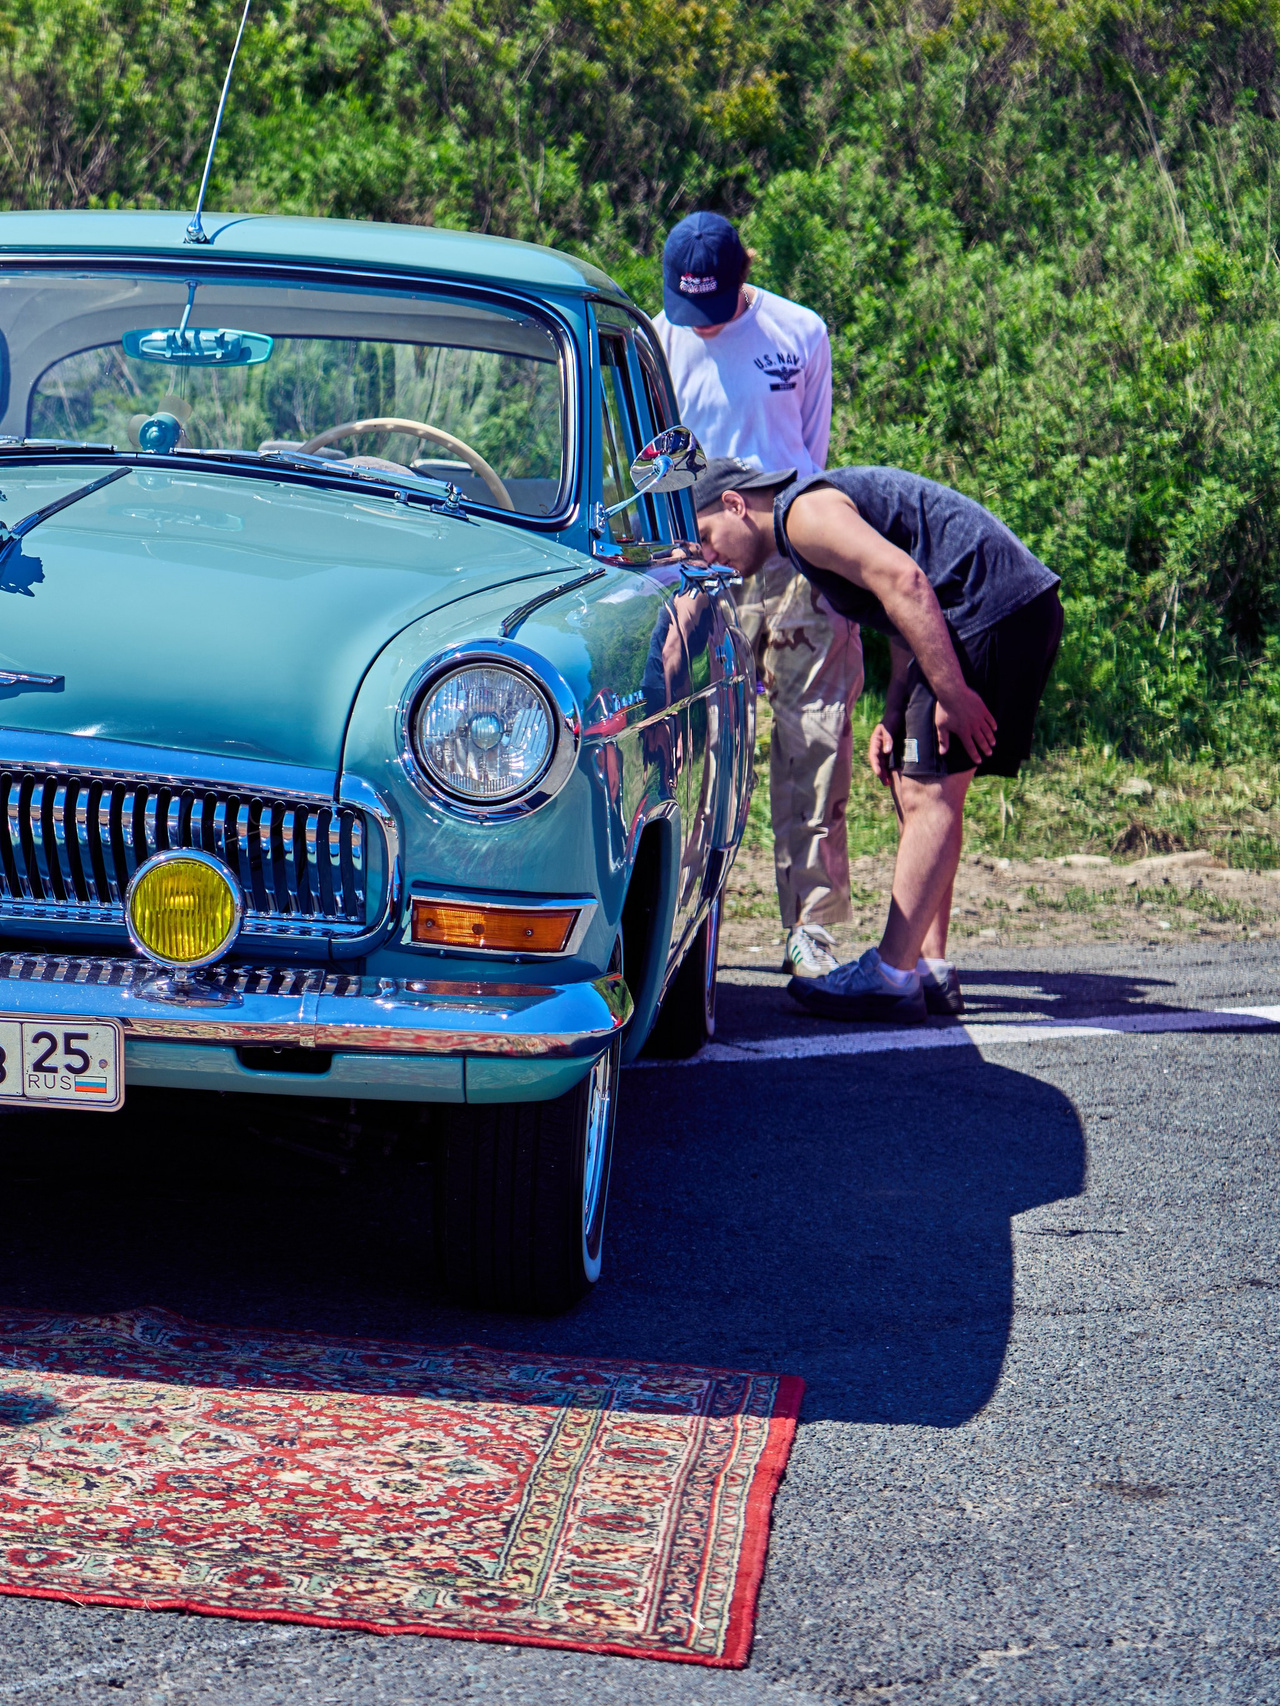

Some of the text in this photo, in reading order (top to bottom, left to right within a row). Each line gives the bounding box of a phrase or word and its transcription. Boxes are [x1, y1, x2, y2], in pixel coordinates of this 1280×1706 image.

[776, 352, 804, 369] NAV
[31, 1031, 91, 1075] 25
[28, 1074, 72, 1091] RUS
